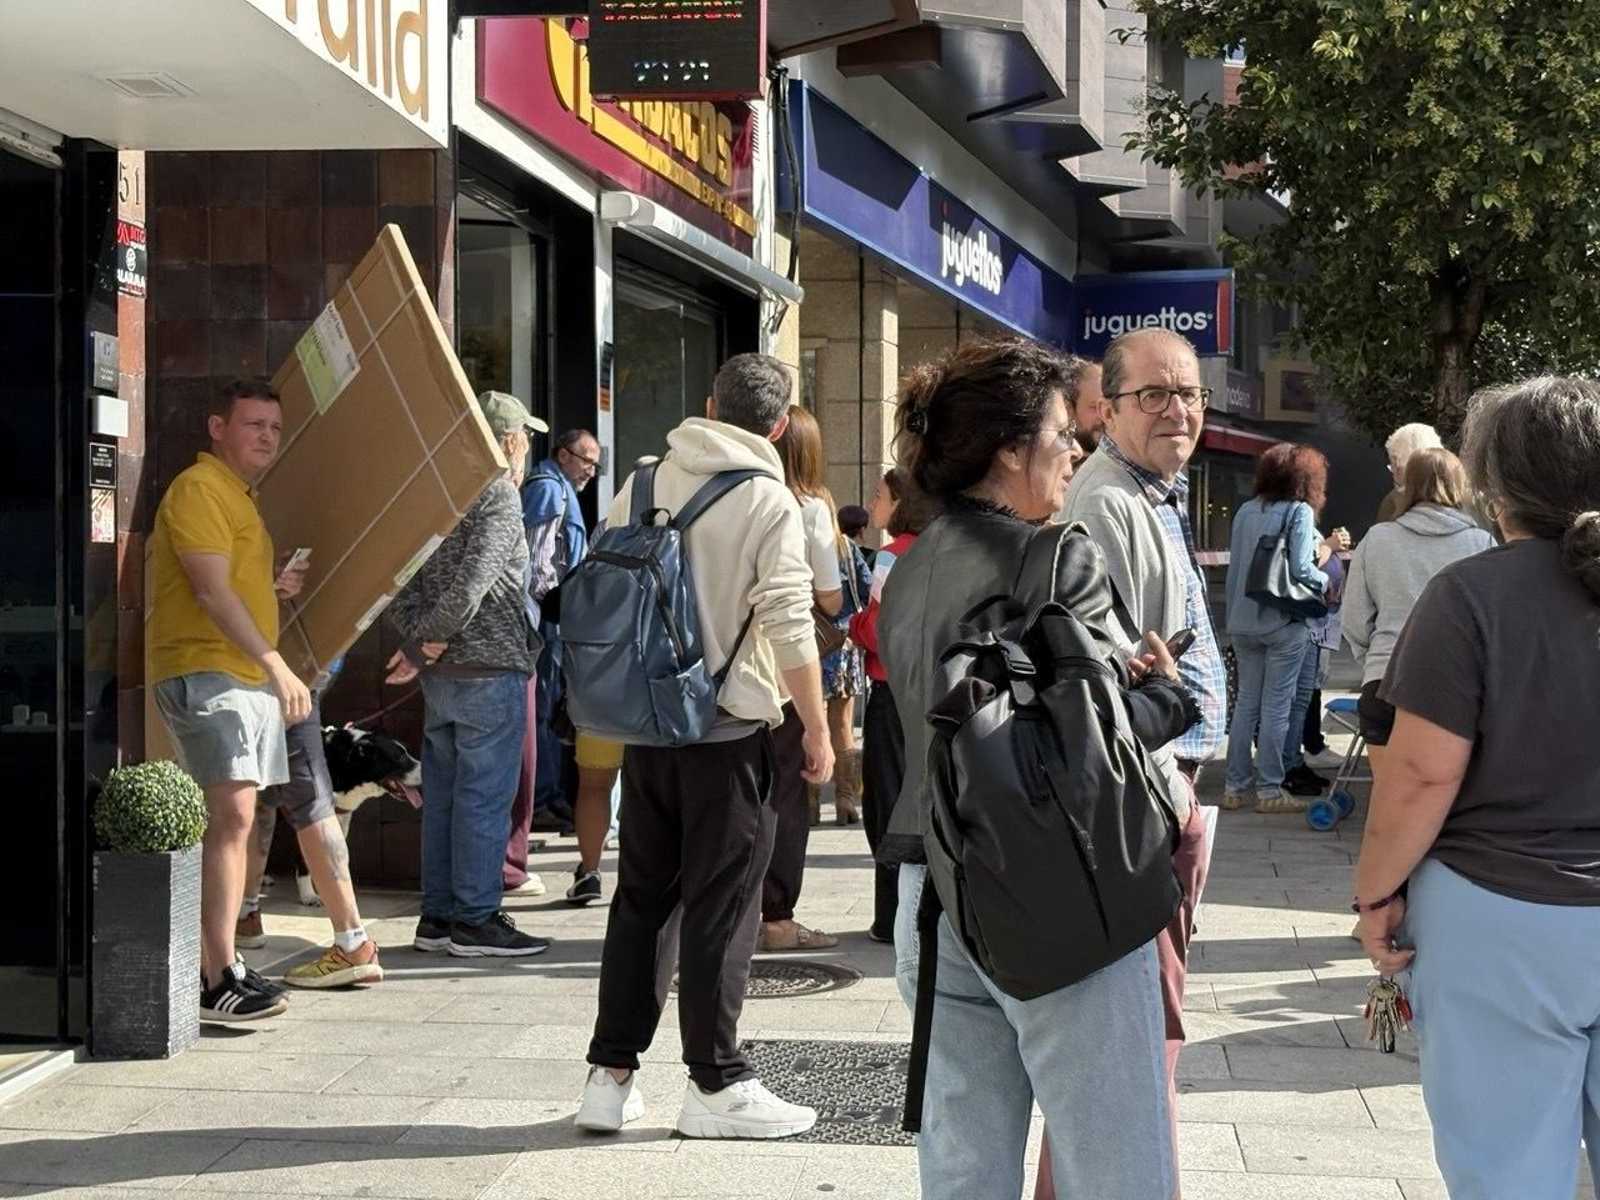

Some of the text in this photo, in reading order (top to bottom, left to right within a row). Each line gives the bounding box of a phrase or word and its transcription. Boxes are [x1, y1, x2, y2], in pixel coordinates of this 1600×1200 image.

[119, 162, 141, 206] 51
[941, 201, 1001, 296] juguettos
[1083, 306, 1208, 341] juguettos
